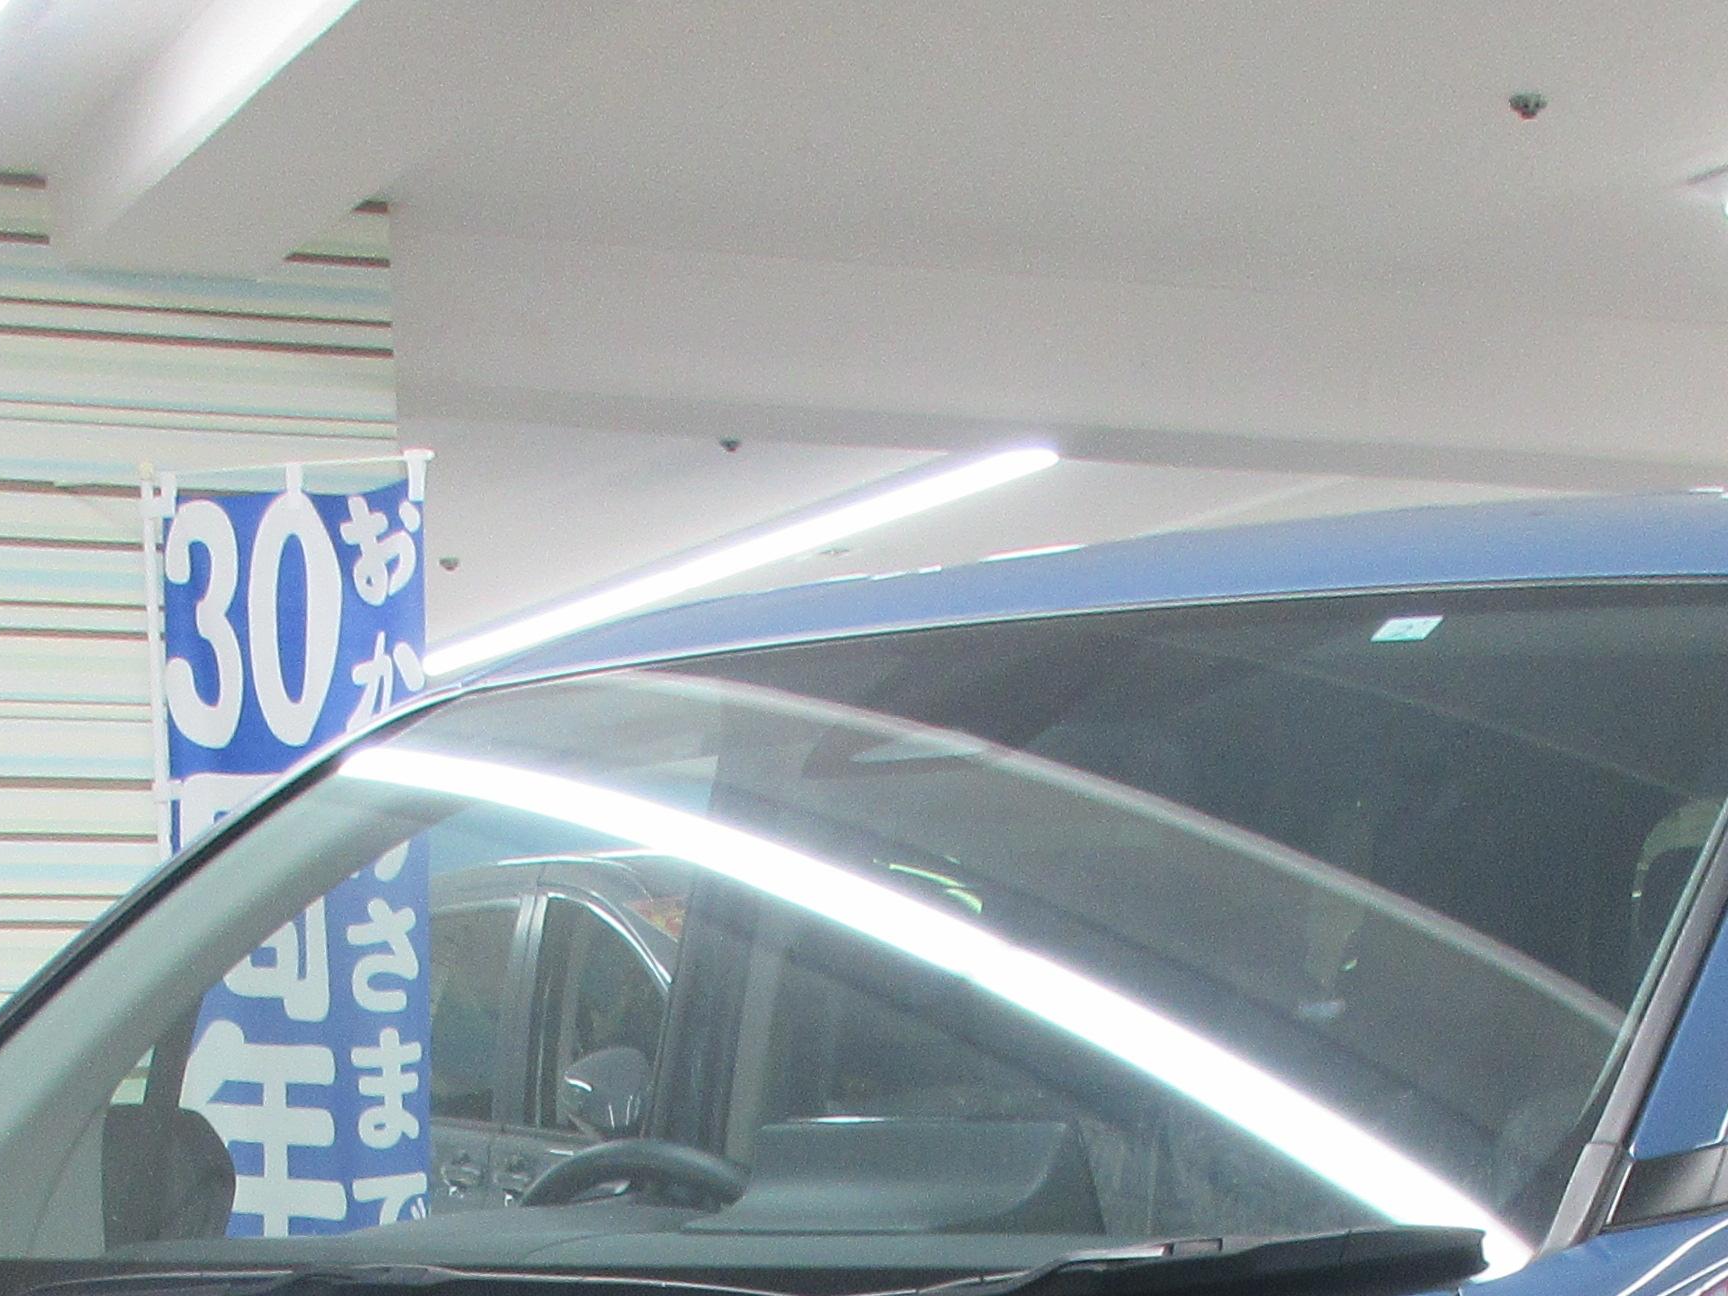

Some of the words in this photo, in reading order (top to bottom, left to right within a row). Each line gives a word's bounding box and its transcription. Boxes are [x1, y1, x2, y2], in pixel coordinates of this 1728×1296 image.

[340, 495, 426, 1224] おかさまで
